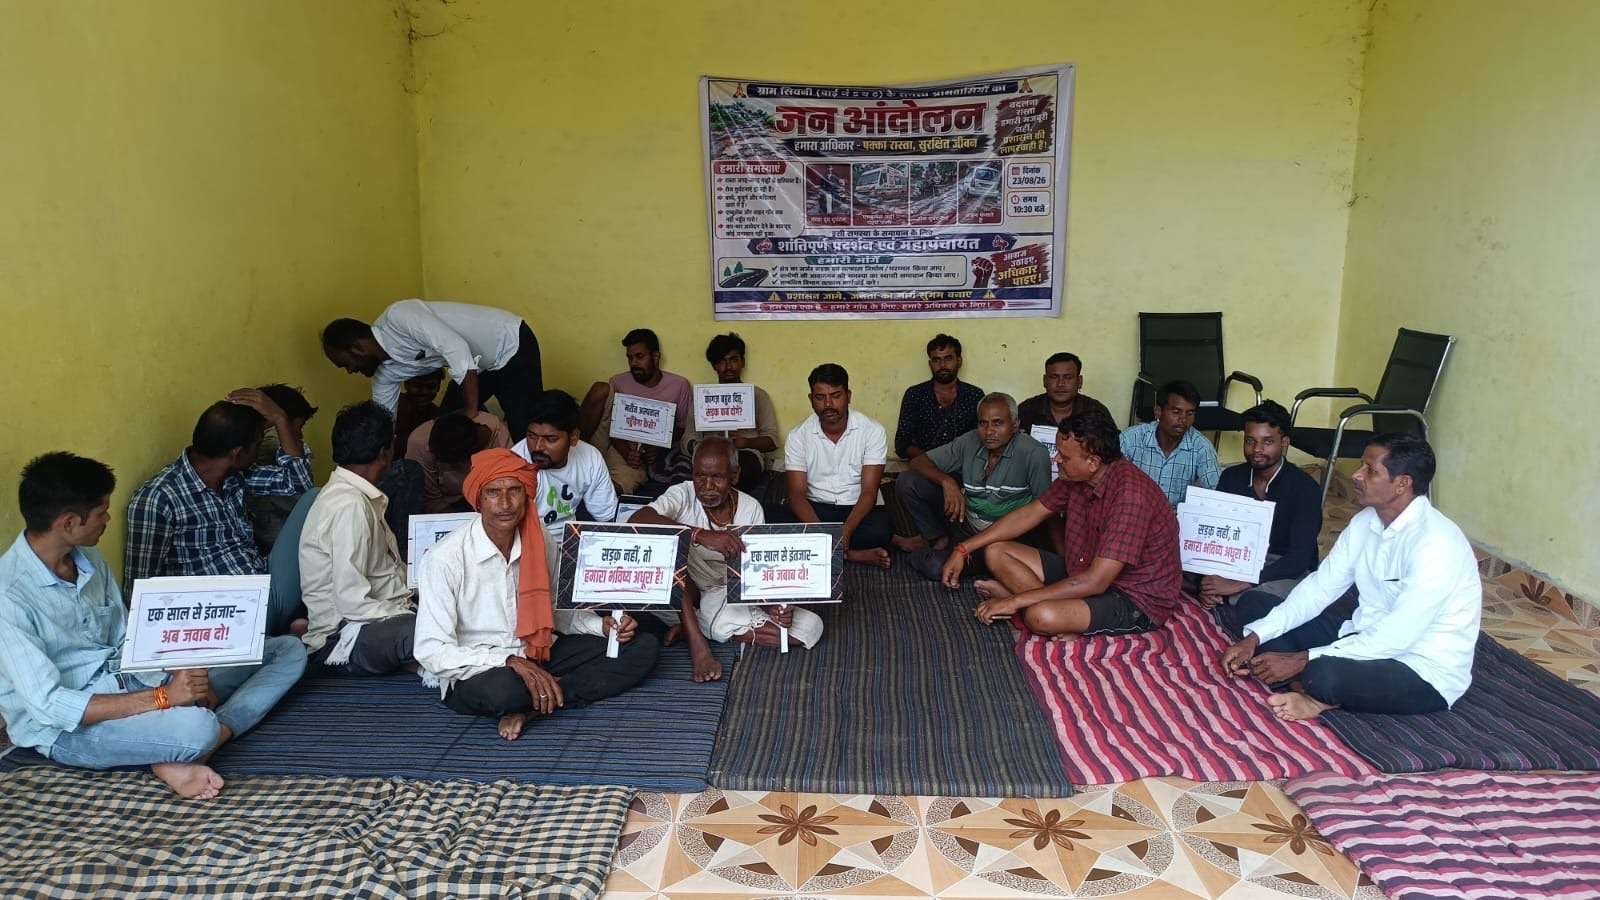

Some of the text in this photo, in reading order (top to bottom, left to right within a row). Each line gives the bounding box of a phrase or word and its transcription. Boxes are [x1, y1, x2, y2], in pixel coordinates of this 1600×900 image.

[757, 87, 777, 96] ग्राम
[775, 100, 988, 134] जन आंदोलन
[794, 140, 818, 151] हमारा
[820, 138, 854, 151] अधिकार
[863, 141, 887, 151] पक्का
[918, 137, 950, 152] सुरक्षित
[953, 136, 977, 149] जीवन
[720, 162, 744, 173] हमारी
[1012, 176, 1046, 185] 23/08/26
[1013, 204, 1045, 213] 10:30 बजे
[778, 237, 828, 255] शांतिपूर्ण
[832, 239, 873, 252] प्रदर्शन
[899, 237, 980, 250] महापंचायत
[817, 255, 851, 264] हमारी
[998, 265, 1038, 280] अधिकार
[1012, 273, 1042, 285] पाइए!
[786, 292, 819, 300] प्रशासन
[924, 301, 957, 309] अधिकार
[1232, 527, 1241, 541] तो
[623, 545, 641, 565] नहीं,
[643, 546, 652, 563] तो
[750, 550, 763, 562] एक
[764, 550, 779, 562] साल
[780, 546, 788, 561] से
[1183, 539, 1252, 563] हमारा भविष्य अधूरा है!
[584, 566, 664, 590] हमारा भविष्य अधूरा है!
[762, 564, 809, 582] अब जवाब दो!
[147, 607, 165, 622] एक
[166, 606, 191, 621] साल
[192, 602, 203, 620] से
[161, 623, 230, 643] अब जवाब दो!
